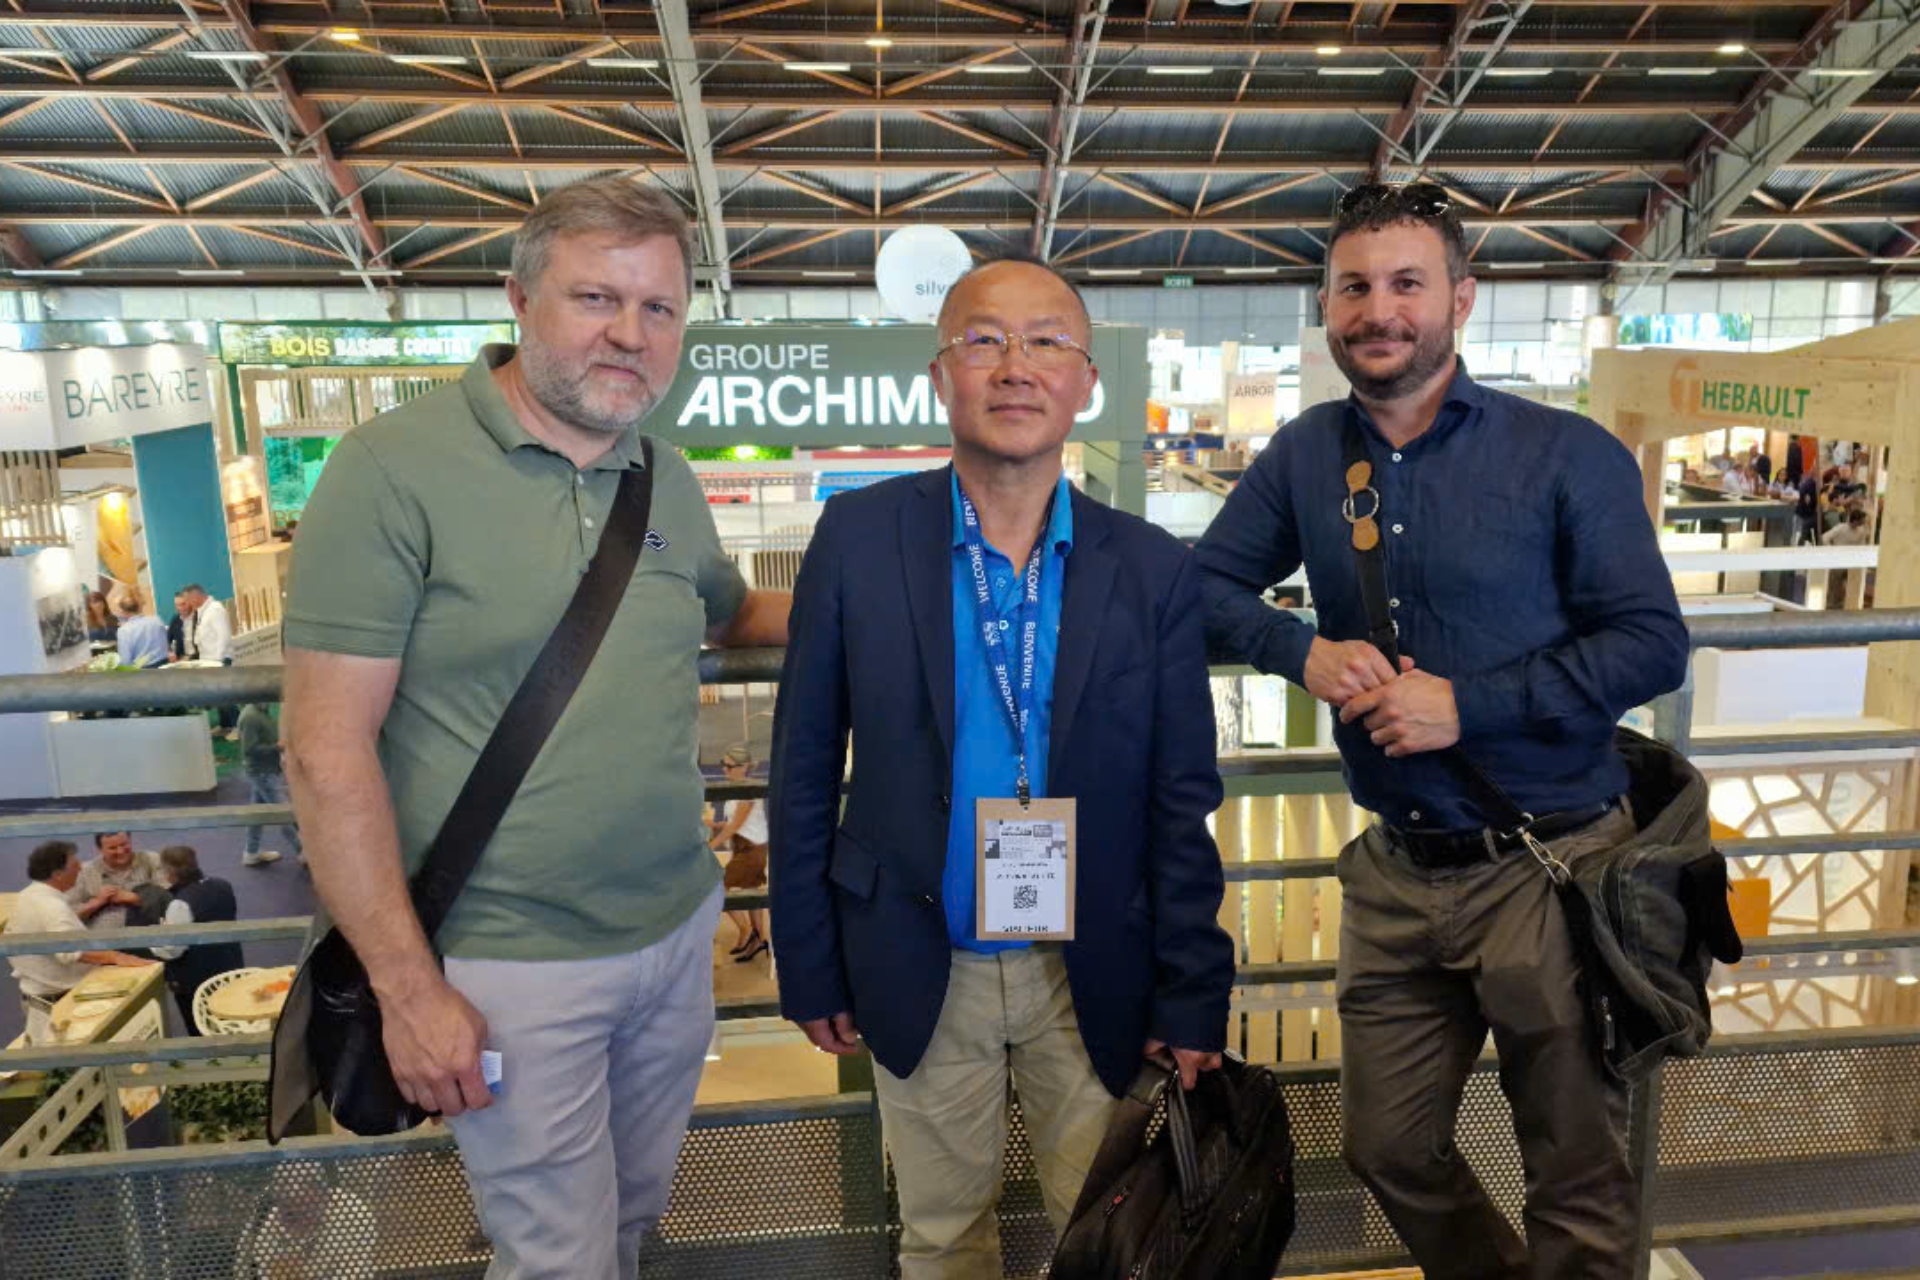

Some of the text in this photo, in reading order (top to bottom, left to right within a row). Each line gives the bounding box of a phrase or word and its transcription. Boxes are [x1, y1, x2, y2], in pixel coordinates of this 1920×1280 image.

[270, 338, 329, 356] BOIS
[689, 344, 829, 370] GROUPE
[63, 368, 201, 418] BAREYRE
[1021, 621, 1036, 689] BIENVENUE
